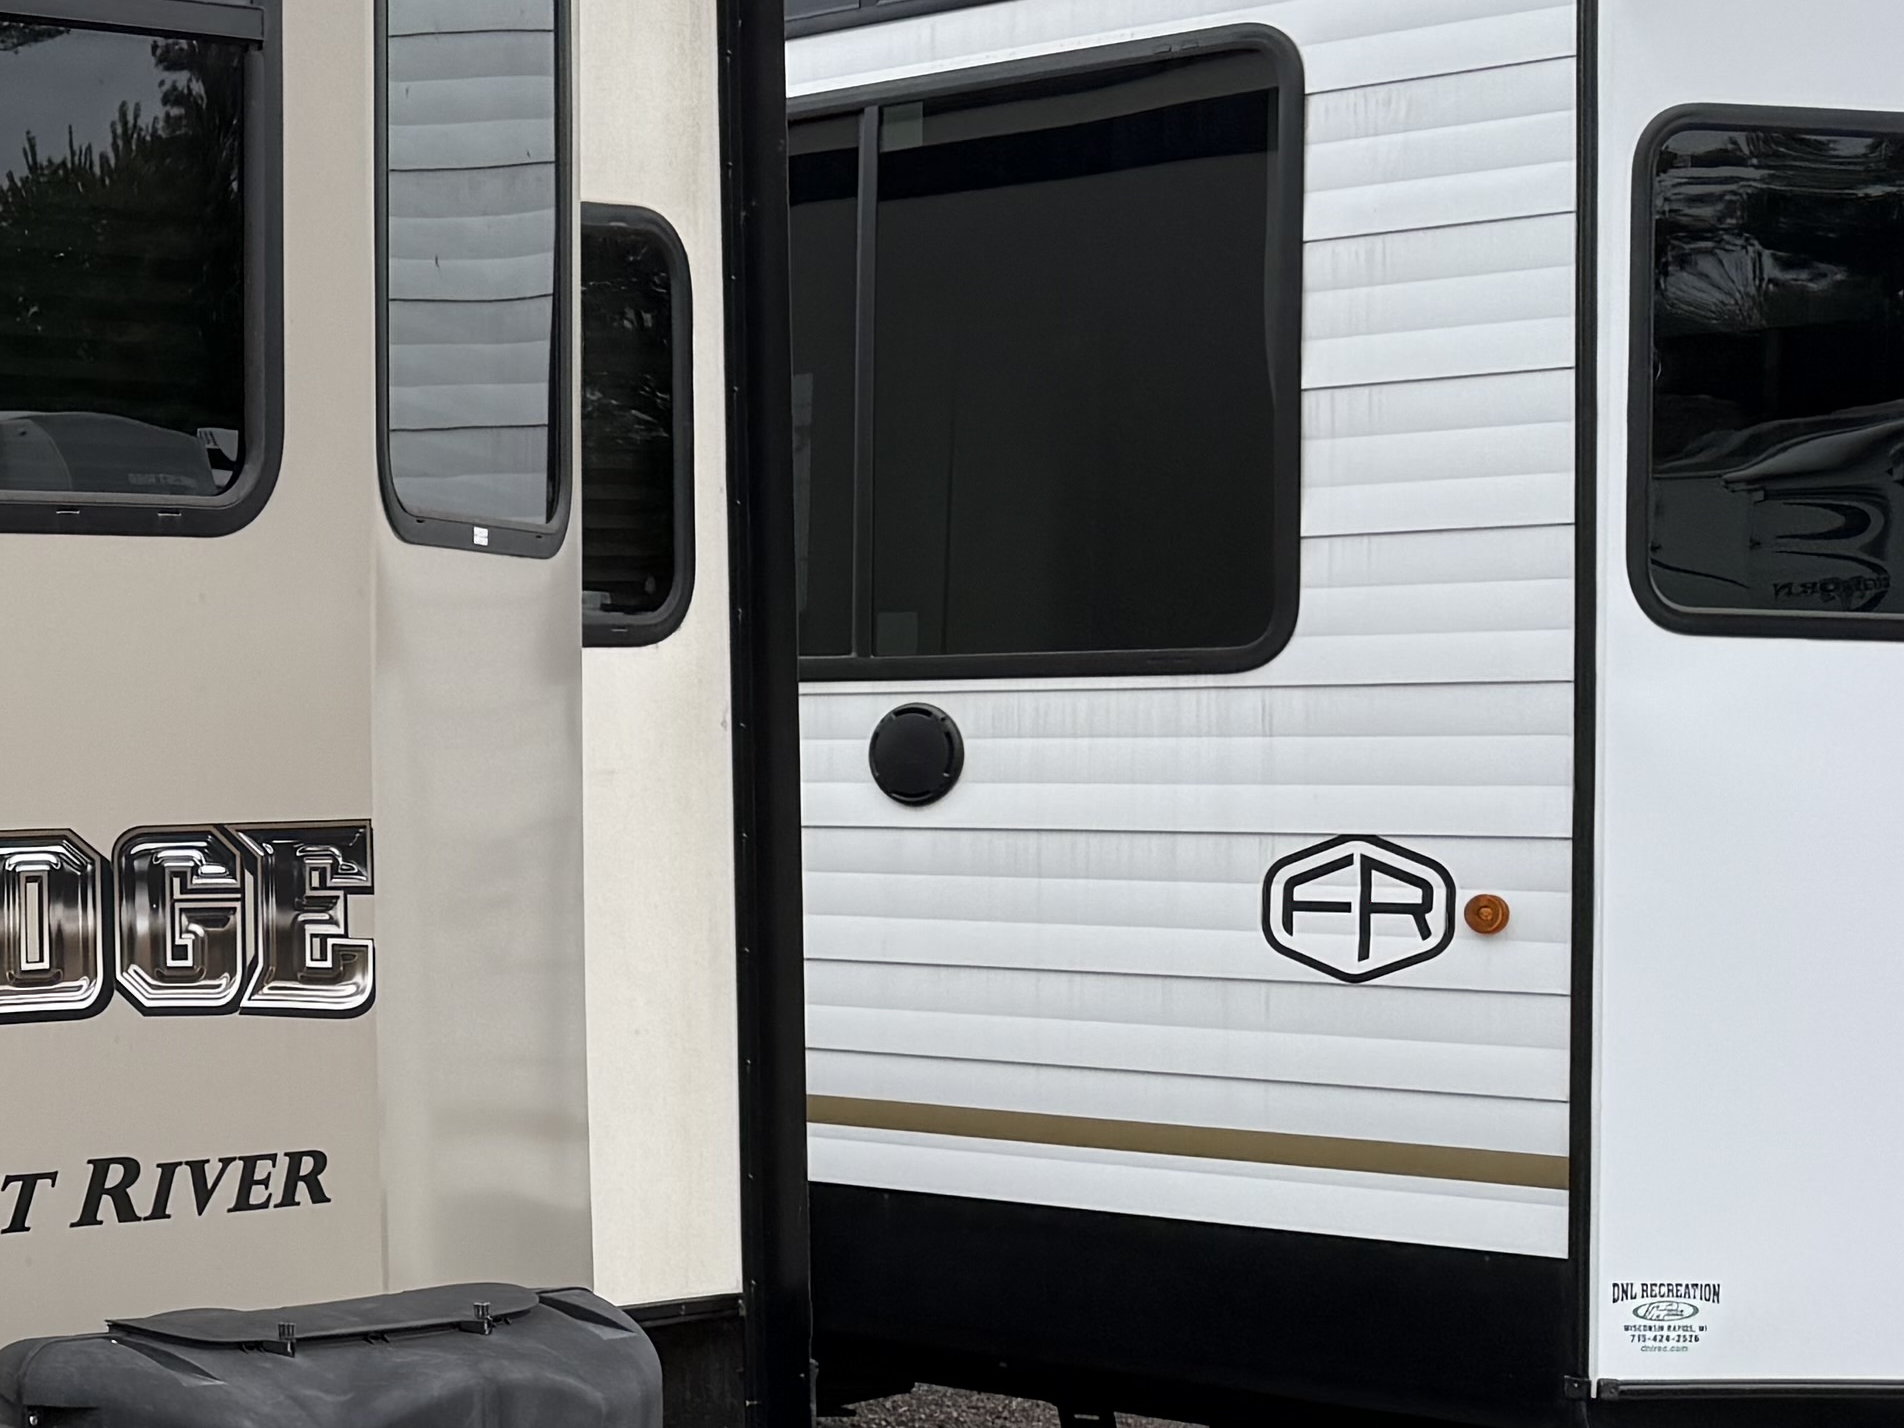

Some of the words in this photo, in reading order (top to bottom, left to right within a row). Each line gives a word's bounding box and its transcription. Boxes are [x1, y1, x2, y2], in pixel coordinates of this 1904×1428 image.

[1281, 852, 1434, 963] FR
[70, 1148, 332, 1229] RIVER
[1612, 1282, 1637, 1304] DNL
[1640, 1282, 1721, 1304] RECREATION
